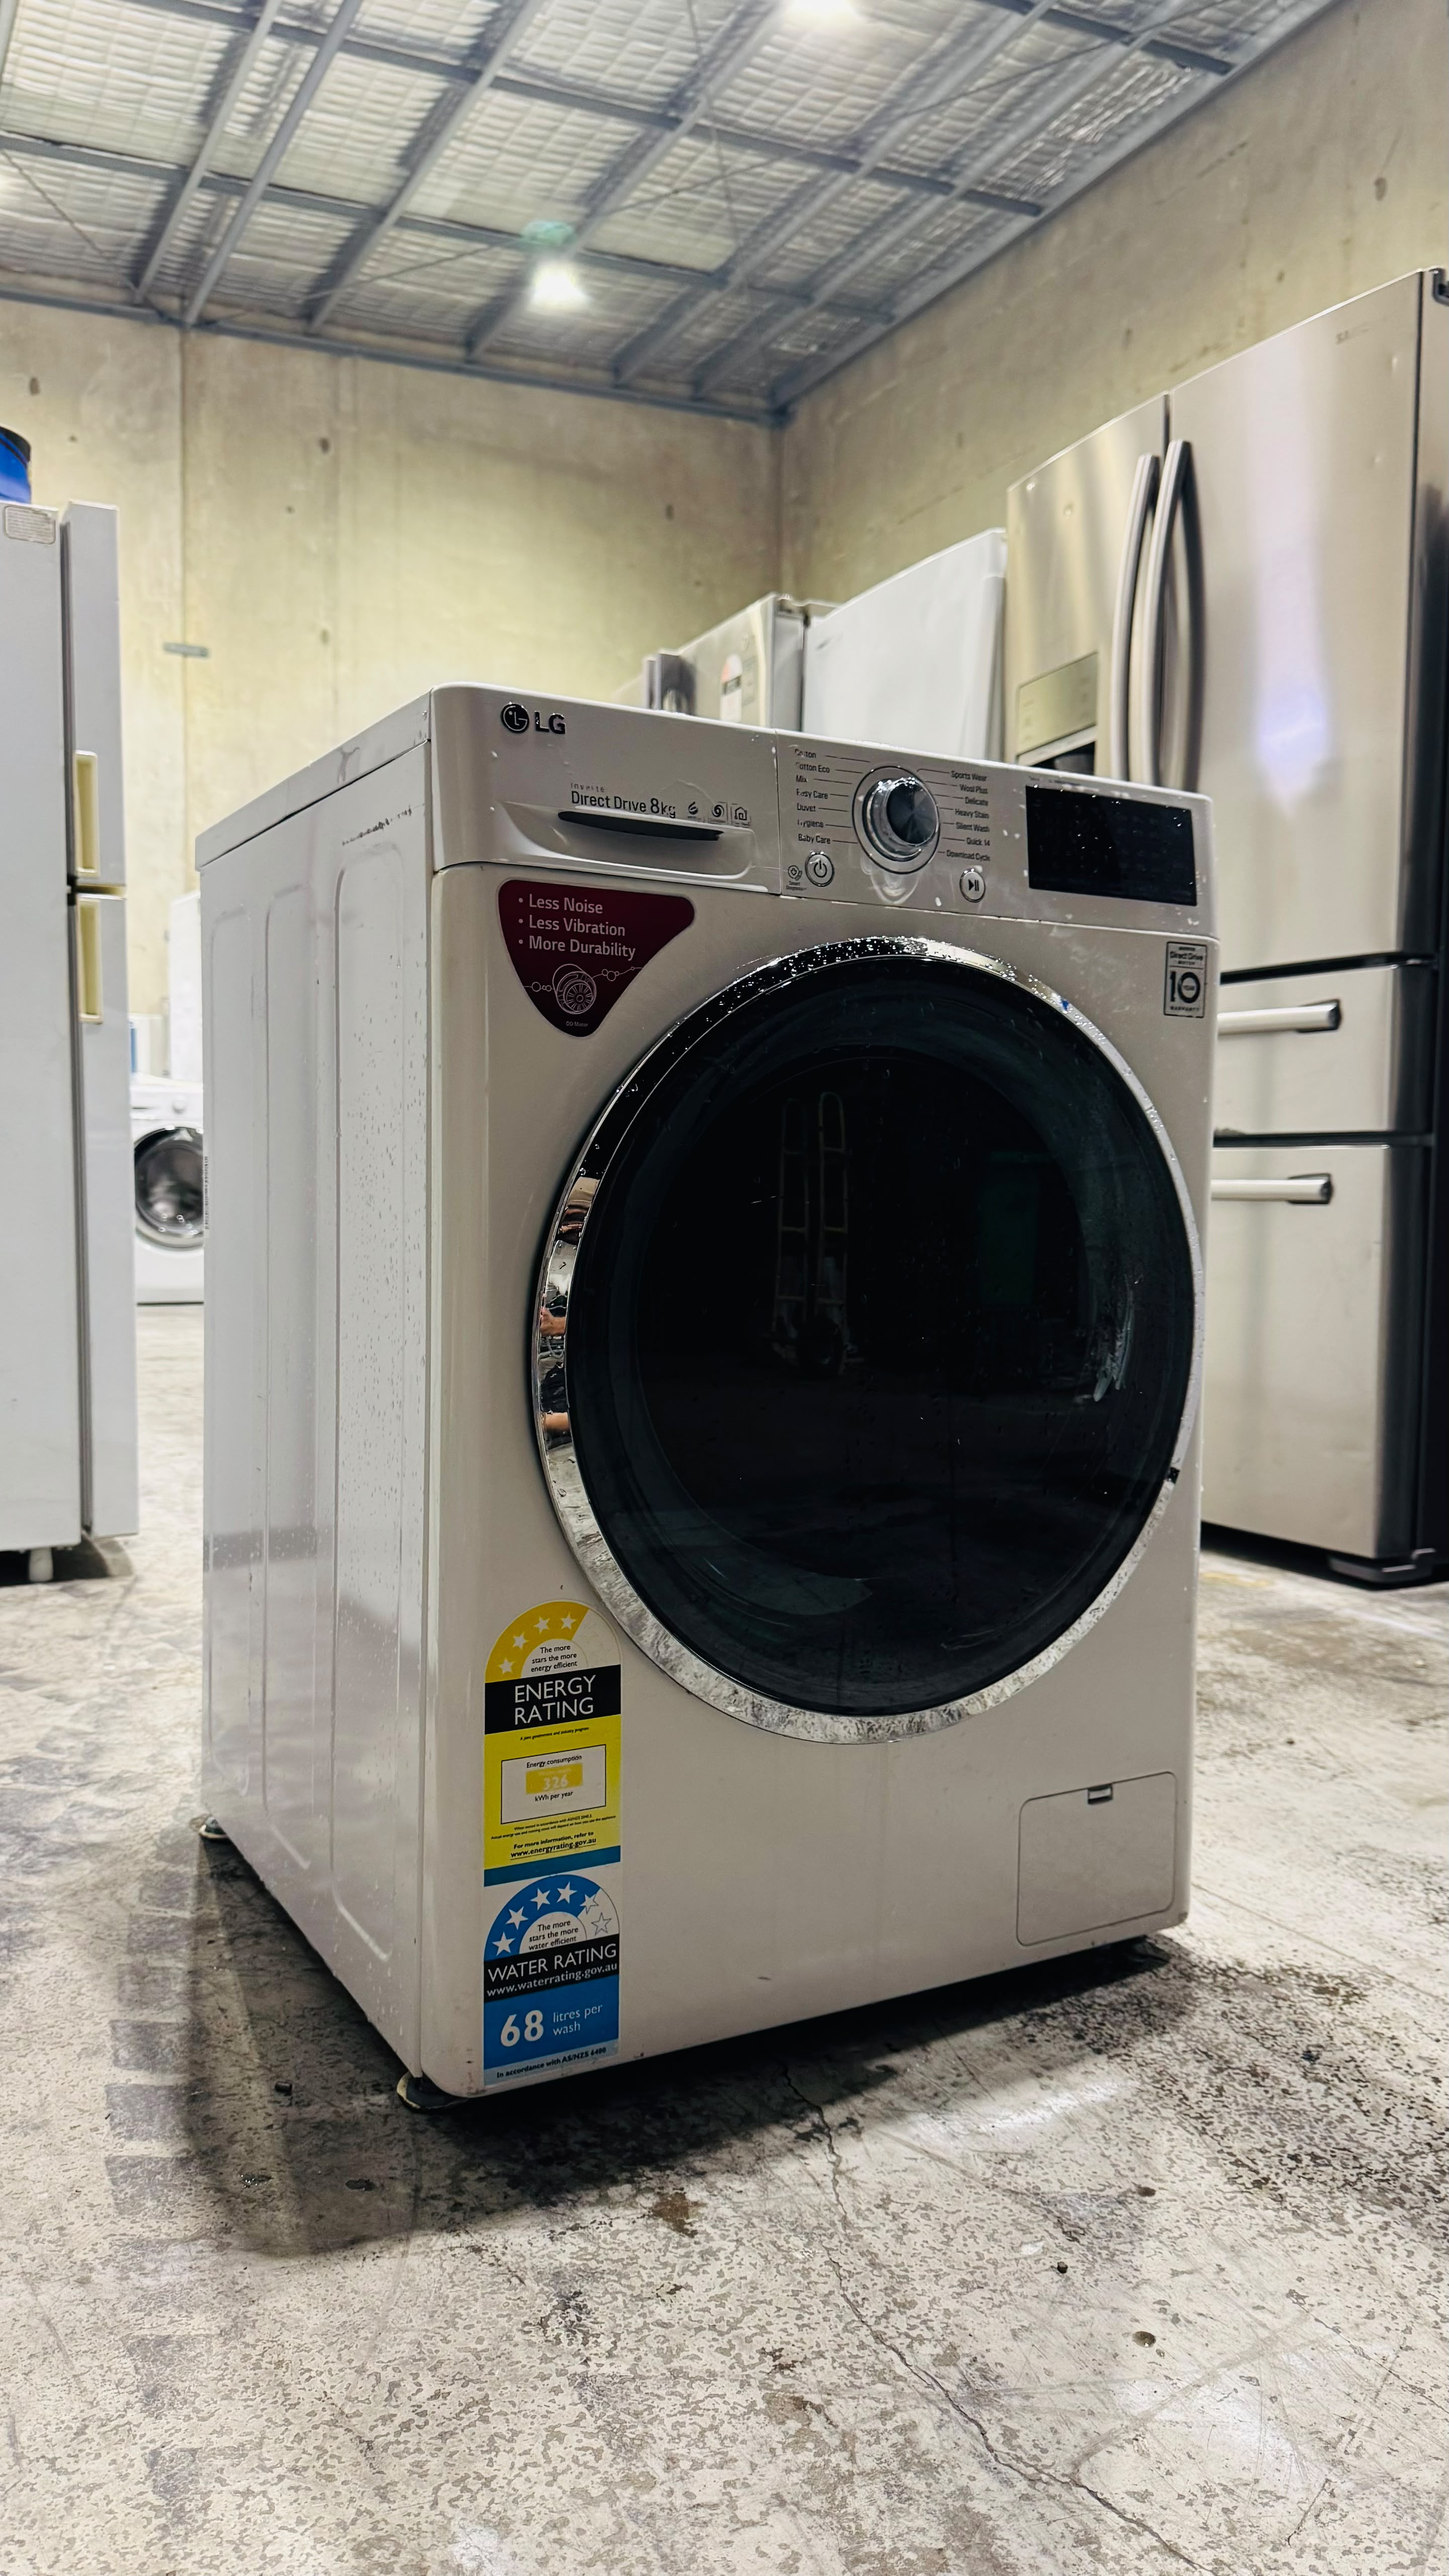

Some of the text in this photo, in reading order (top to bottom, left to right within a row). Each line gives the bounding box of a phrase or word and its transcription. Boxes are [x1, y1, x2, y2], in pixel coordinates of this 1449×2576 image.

[534, 710, 566, 735] LG
[795, 749, 816, 758] Coton
[795, 762, 830, 773] otton Eco
[572, 791, 611, 808] Direct
[614, 796, 647, 813] Drive
[796, 788, 828, 799] Easy Care
[797, 802, 816, 812] Duvet
[955, 809, 974, 819] Heavy
[798, 833, 831, 844] Baby Care
[529, 894, 603, 914] Less Noise
[529, 915, 625, 936] Less Vibration
[529, 935, 635, 961] More Durability
[1170, 971, 1200, 1003] 10
[515, 1674, 596, 1703] ENERGY
[515, 1697, 594, 1725] RATING
[547, 1755, 582, 1765] consumption
[510, 1838, 596, 1858] www.energyrating.gov.au
[540, 1835, 573, 1845] information,
[552, 1920, 571, 1928] more
[529, 1934, 545, 1942] stars
[560, 1927, 578, 1936] more
[529, 1936, 576, 1951] water efficient
[488, 1944, 616, 1982] WATER RATING
[487, 1963, 617, 1996] www.waterrating.gov.au
[501, 2004, 602, 2047] 68 litres per
[553, 2021, 580, 2036] wash
[506, 2063, 544, 2076] accordance
[546, 2058, 560, 2066] with
[561, 2051, 589, 2063] AS/NZS
